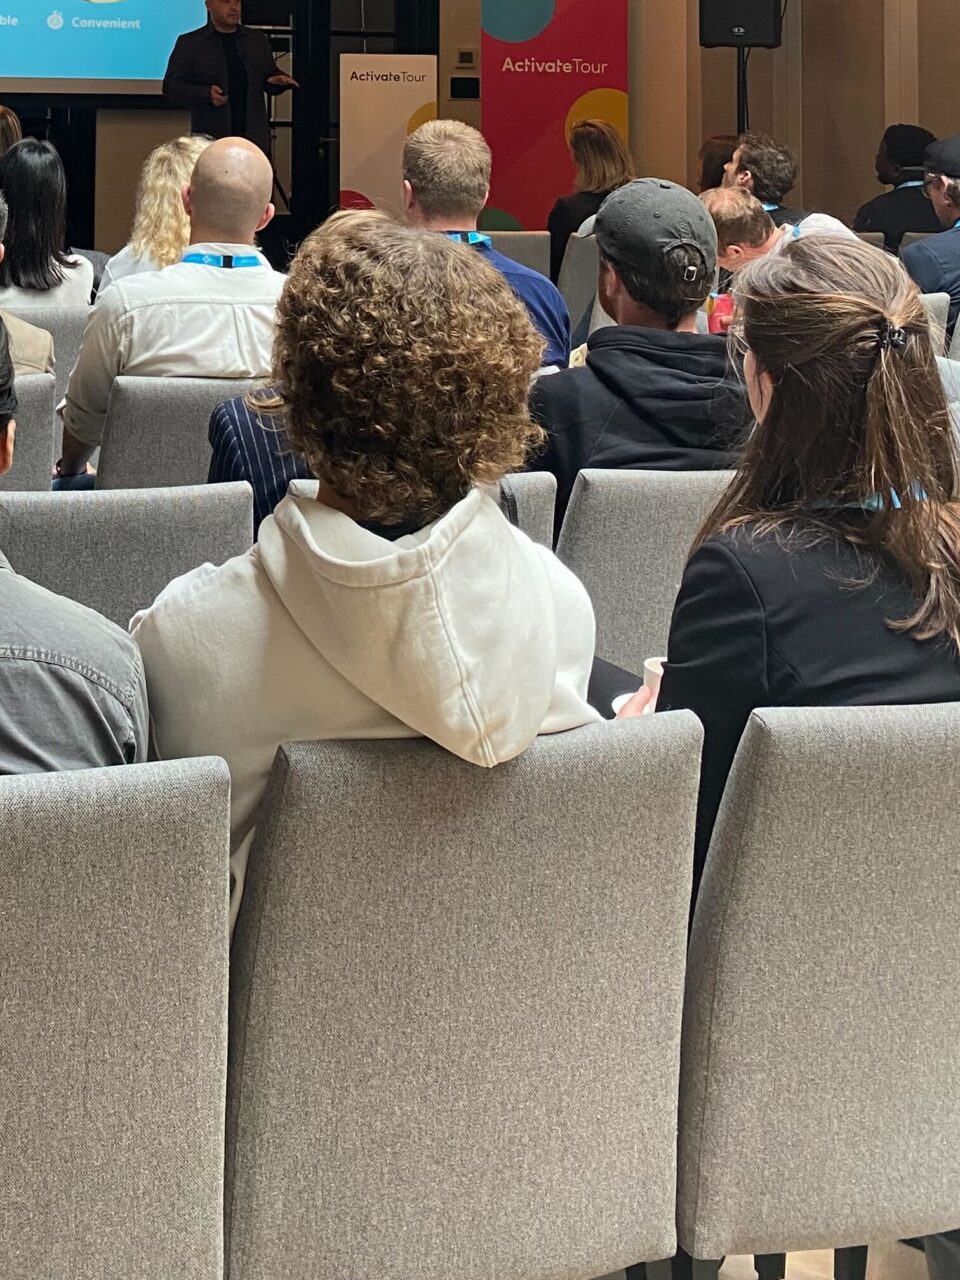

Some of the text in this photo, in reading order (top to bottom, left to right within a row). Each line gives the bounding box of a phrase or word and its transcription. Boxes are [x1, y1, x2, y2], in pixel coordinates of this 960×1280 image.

[71, 16, 141, 29] Convenient
[501, 56, 609, 74] ActivateTour
[349, 70, 428, 82] ActivateTour
